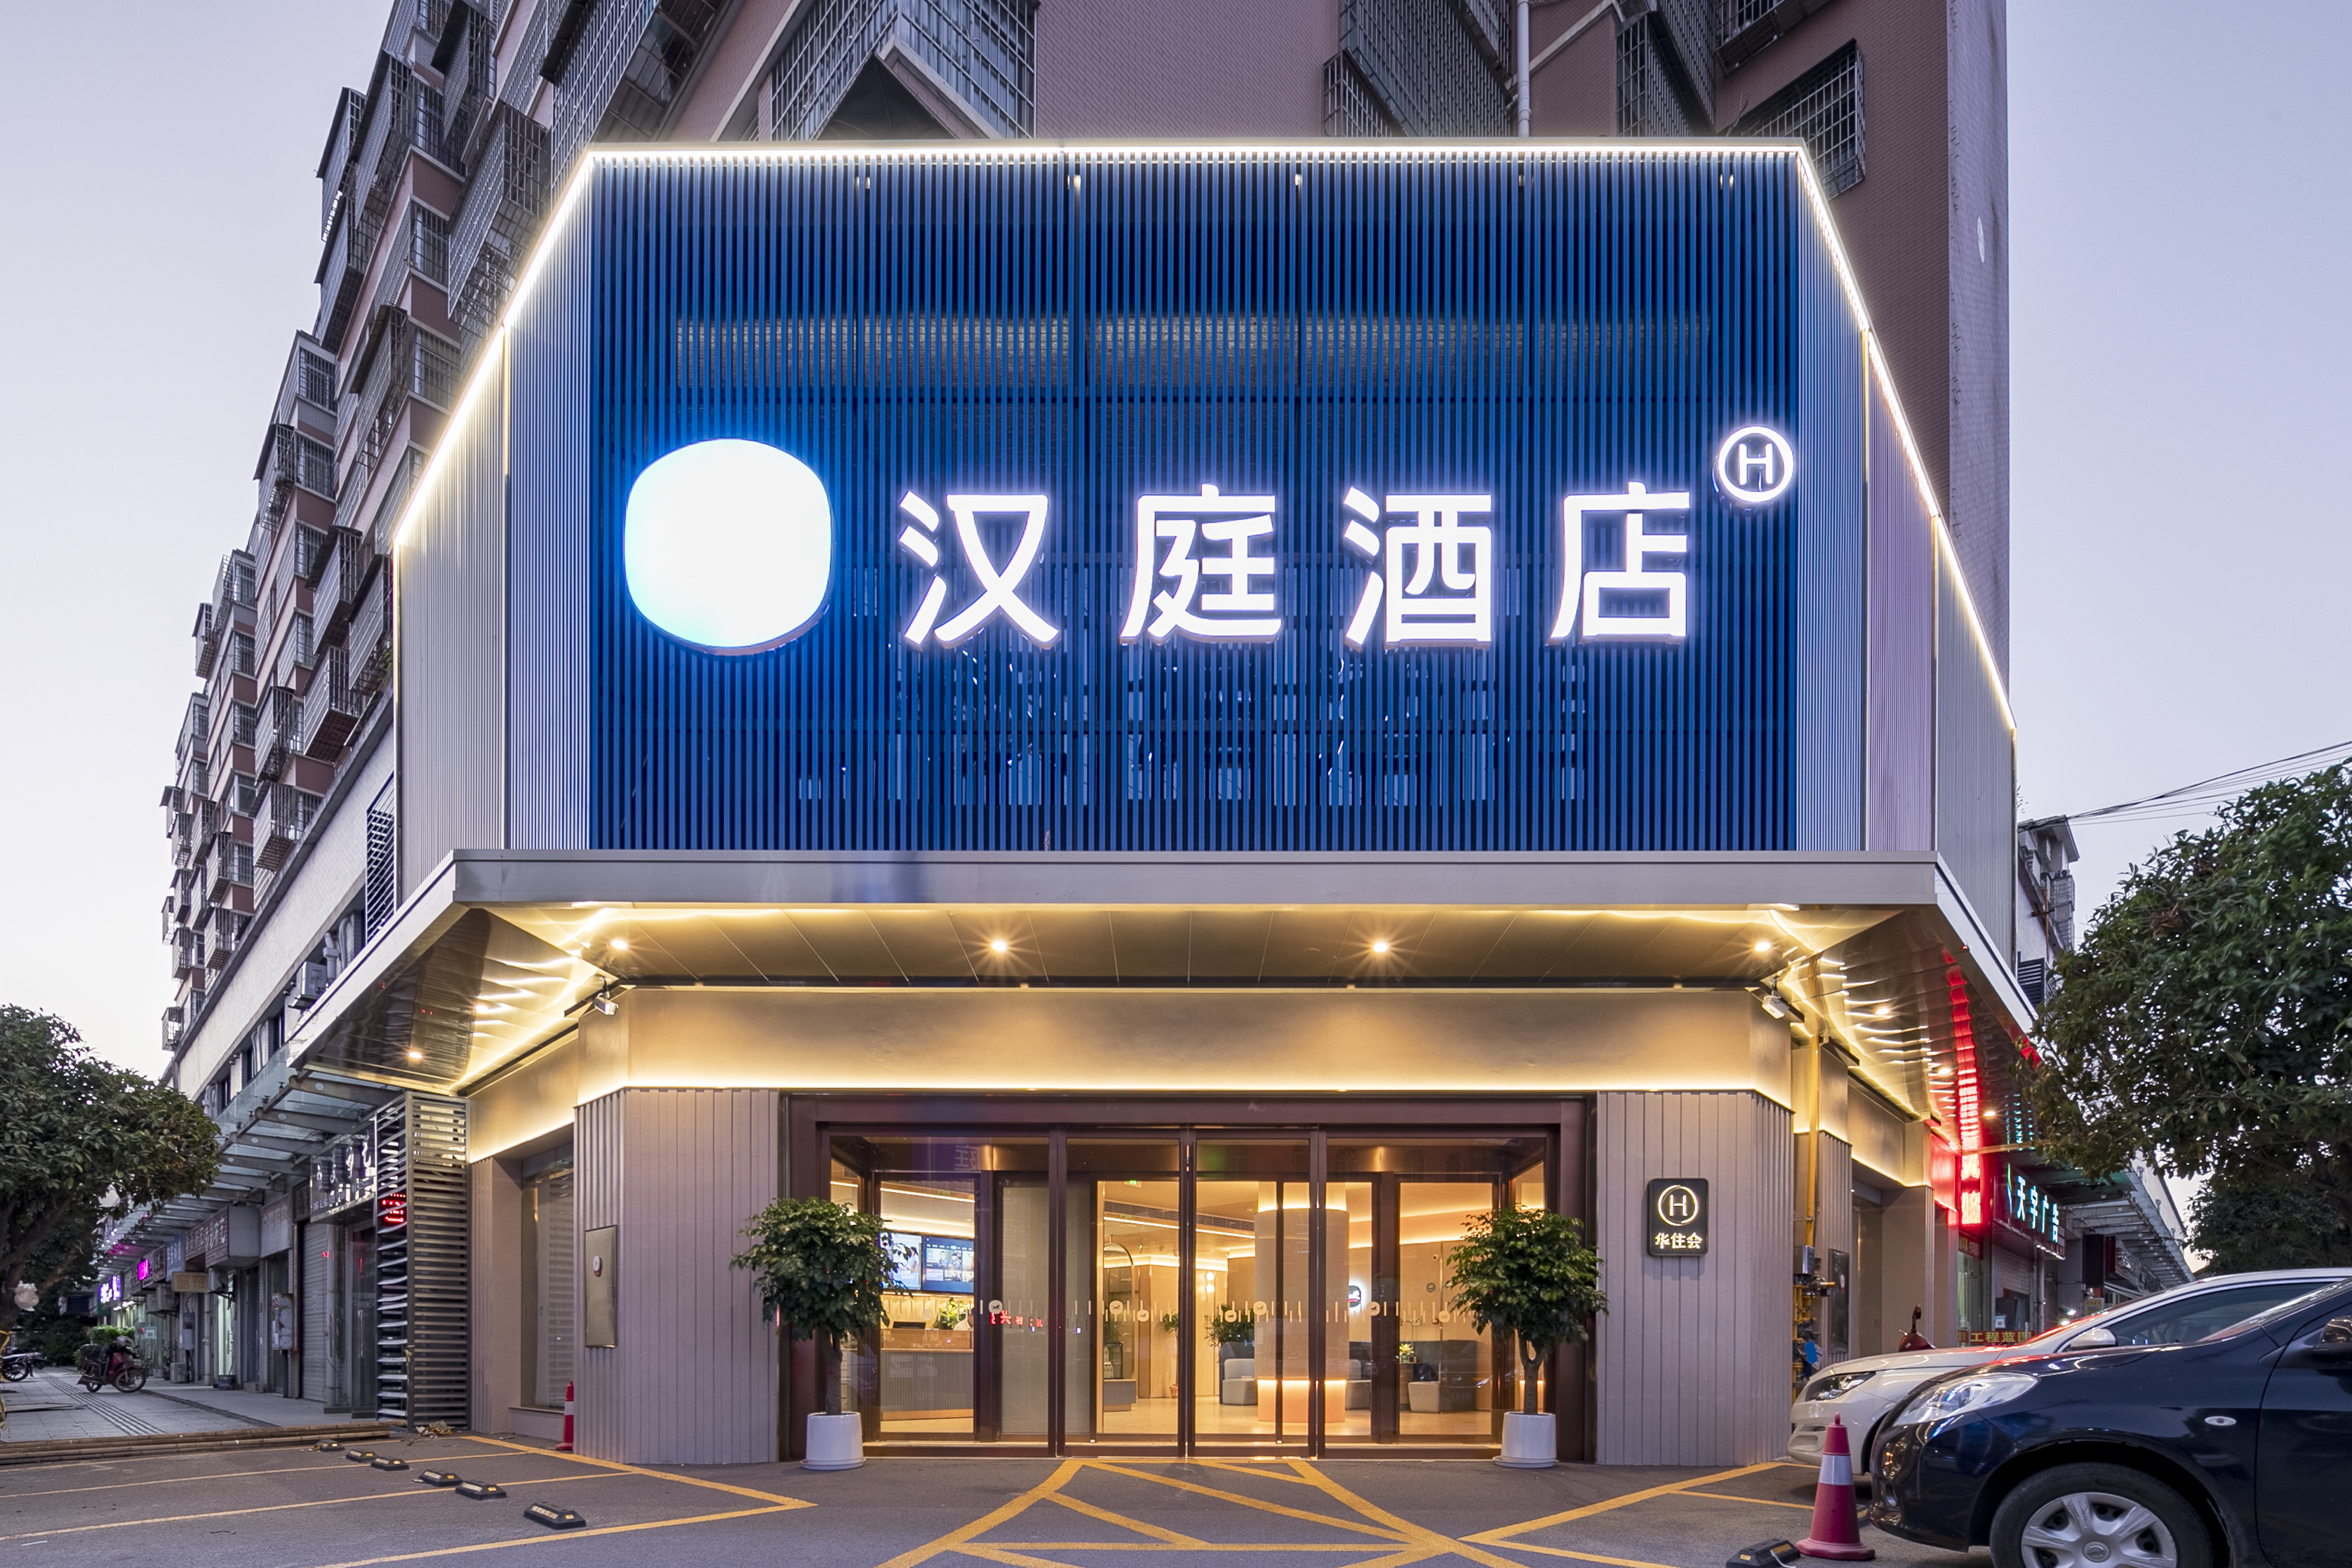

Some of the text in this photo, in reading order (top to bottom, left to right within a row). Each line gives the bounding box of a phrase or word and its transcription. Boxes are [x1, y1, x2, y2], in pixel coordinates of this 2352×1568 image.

[900, 483, 1690, 645] 汉庭酒店
[1655, 1232, 1703, 1249] 华住会
[2017, 1176, 2059, 1242] 天宇广告
